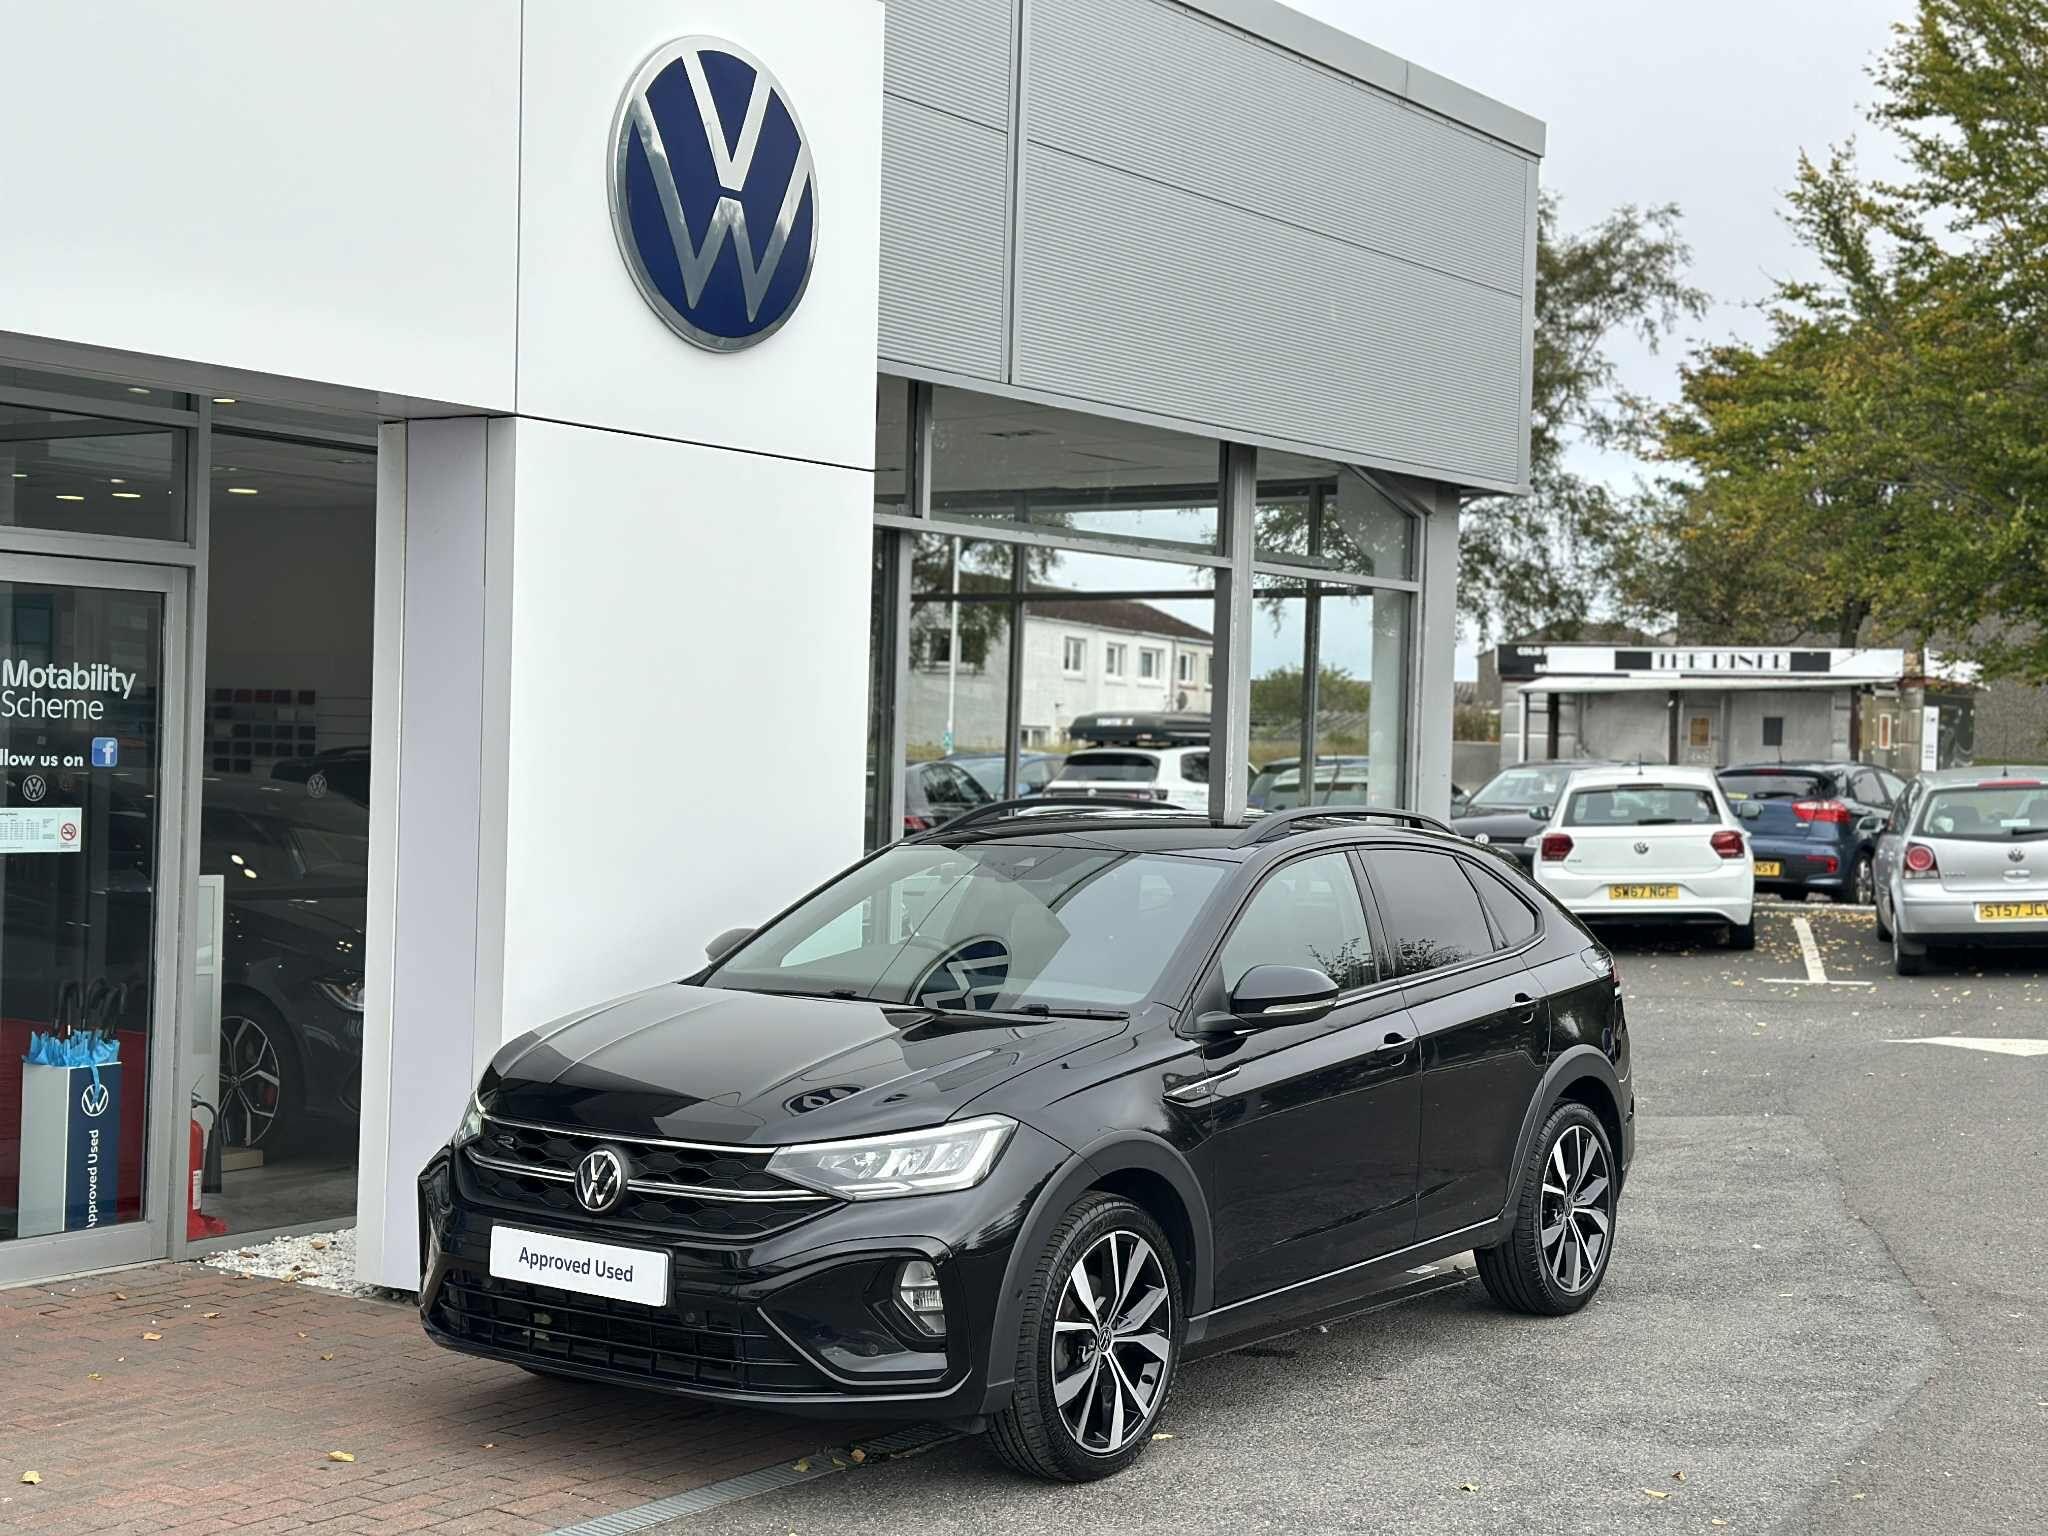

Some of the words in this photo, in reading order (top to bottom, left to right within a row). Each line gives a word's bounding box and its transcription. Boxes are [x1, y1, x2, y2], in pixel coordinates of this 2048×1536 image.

[608, 34, 819, 353] VW
[2, 658, 137, 699] Motability
[1654, 652, 1703, 671] THE
[1711, 652, 1789, 671] DINER
[1, 689, 104, 720] Scheme
[40, 755, 59, 767] us
[63, 755, 84, 767] on
[1984, 904, 2020, 917] ST57
[88, 1129, 99, 1164] Used
[575, 1149, 622, 1212] VW
[518, 1246, 591, 1275] Approved
[595, 1259, 634, 1282] Used
